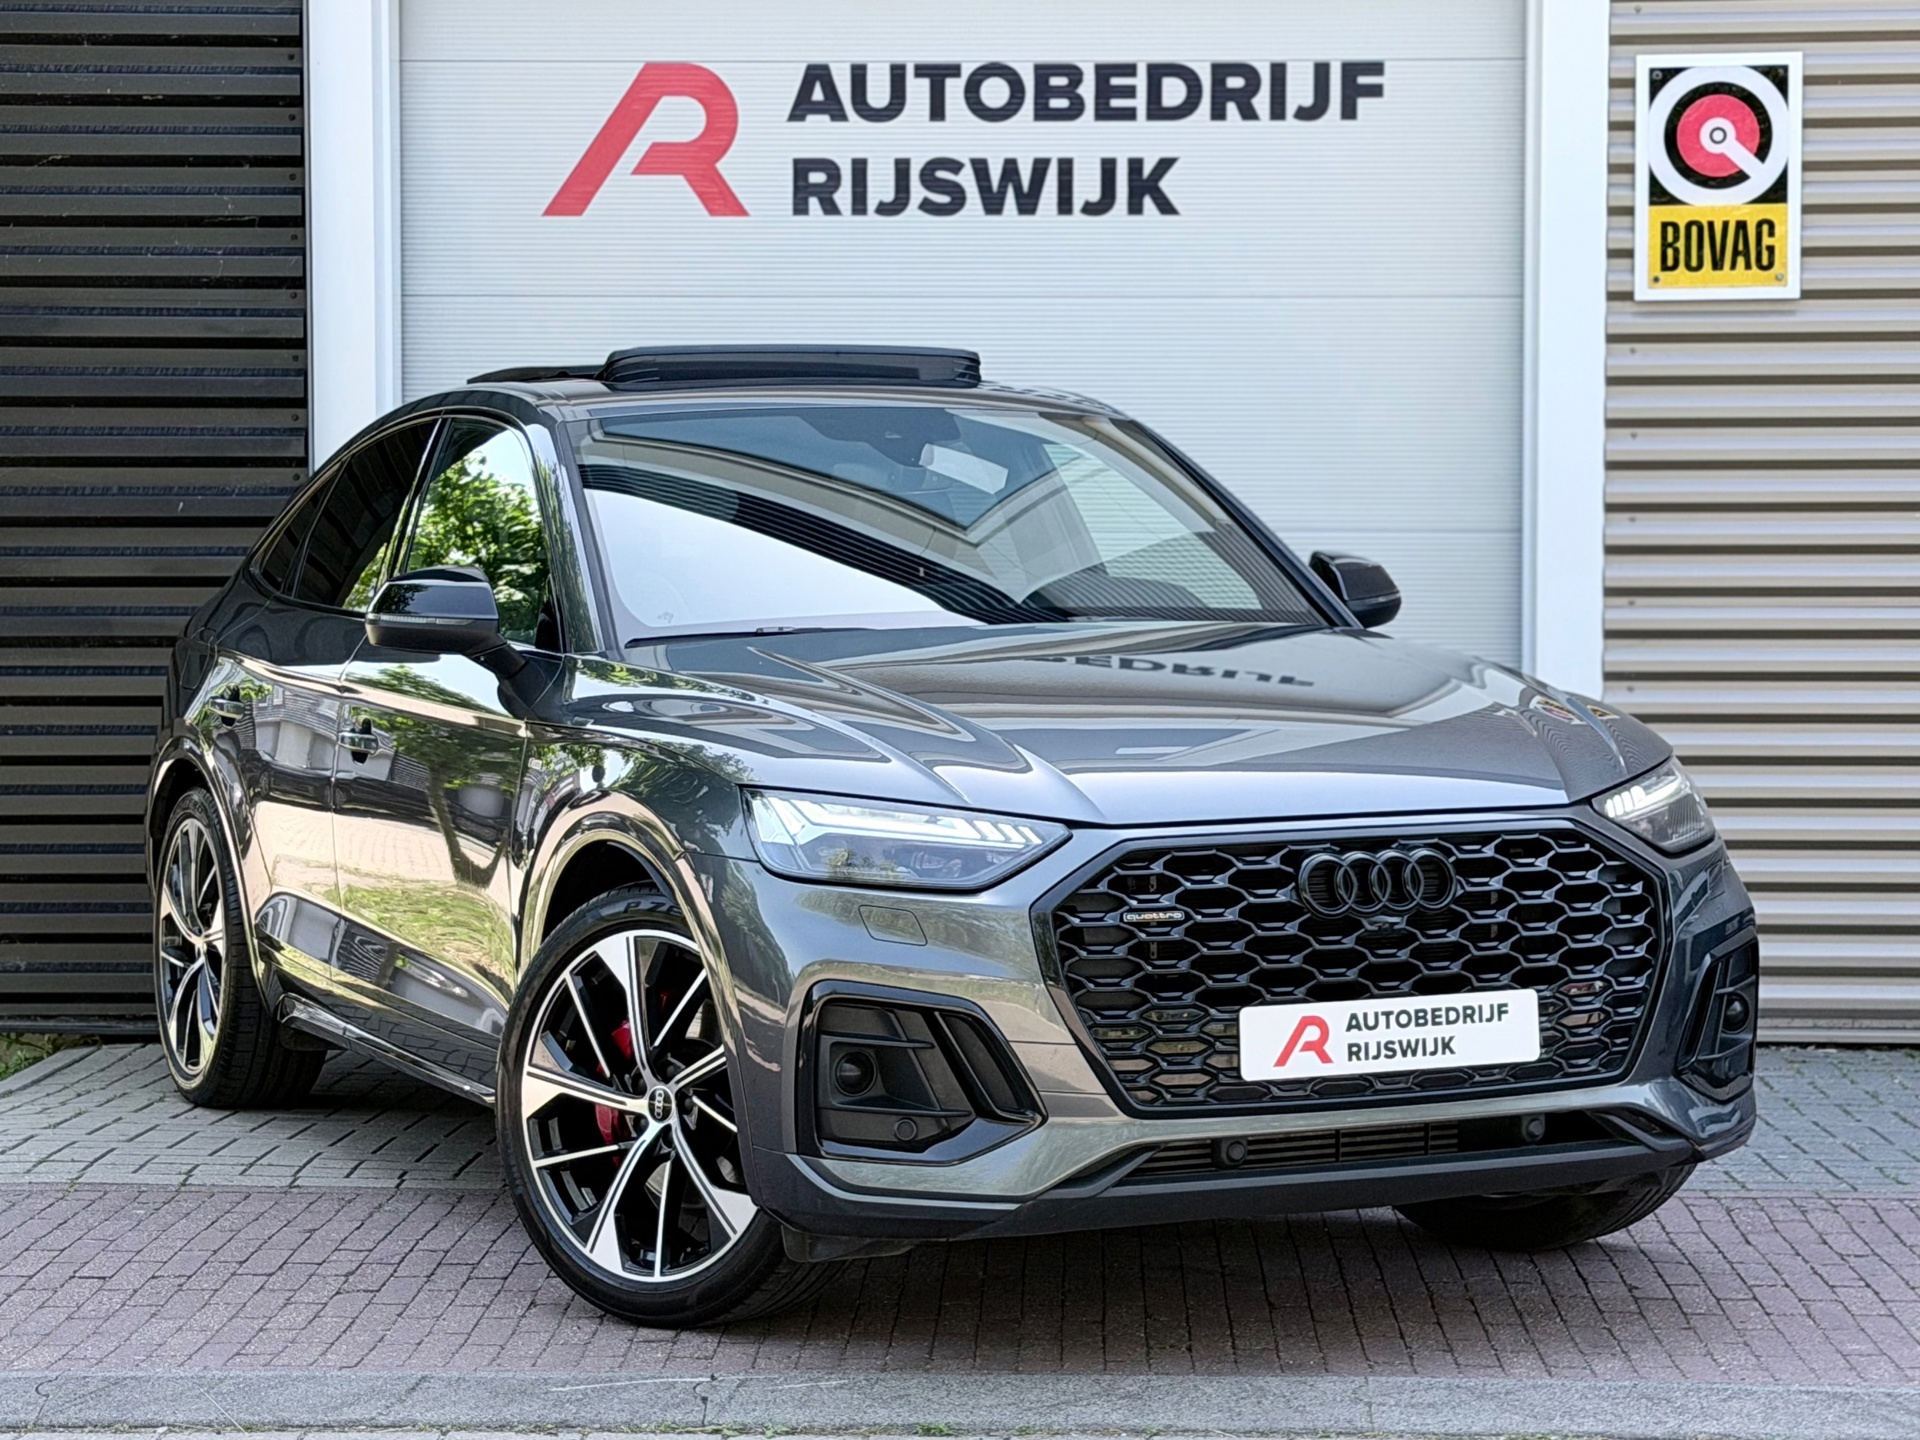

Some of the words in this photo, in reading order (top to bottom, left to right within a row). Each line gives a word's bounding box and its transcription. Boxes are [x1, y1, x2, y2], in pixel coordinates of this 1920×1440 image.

[787, 61, 1384, 123] AUTOBEDRIJF
[792, 157, 1181, 216] RIJSWIJK
[1660, 218, 1776, 272] BOVAG
[1126, 912, 1183, 921] quattro
[1345, 1003, 1509, 1032] AUTOBEDRIJF
[1347, 1036, 1456, 1062] RIJSWIJK
